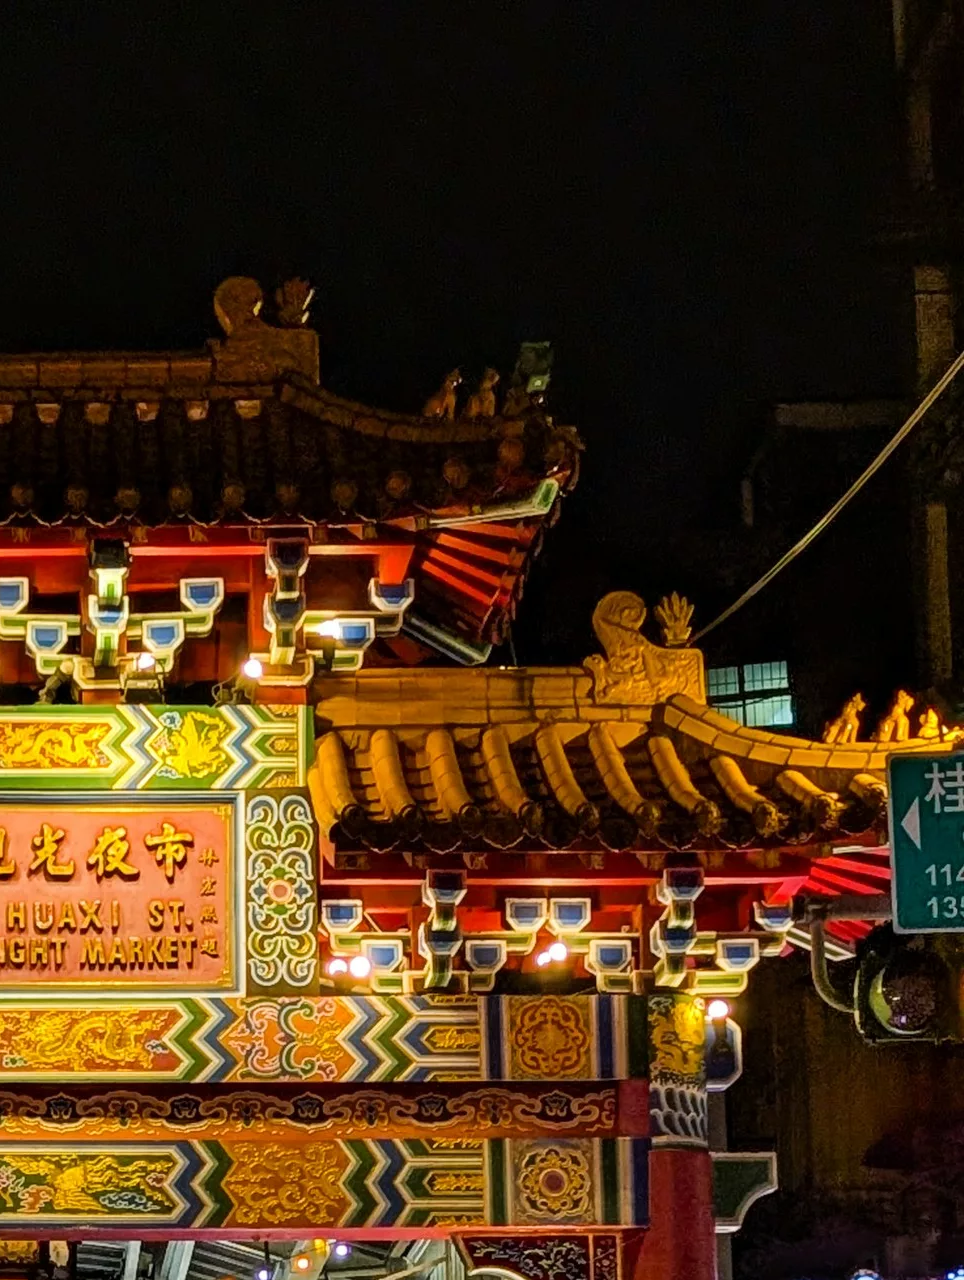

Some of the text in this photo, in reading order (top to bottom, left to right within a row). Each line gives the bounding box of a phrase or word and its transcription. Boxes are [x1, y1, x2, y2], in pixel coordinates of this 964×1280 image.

[7, 900, 123, 934] HUAXI
[148, 900, 194, 934] ST.
[79, 937, 199, 971] MARKET
